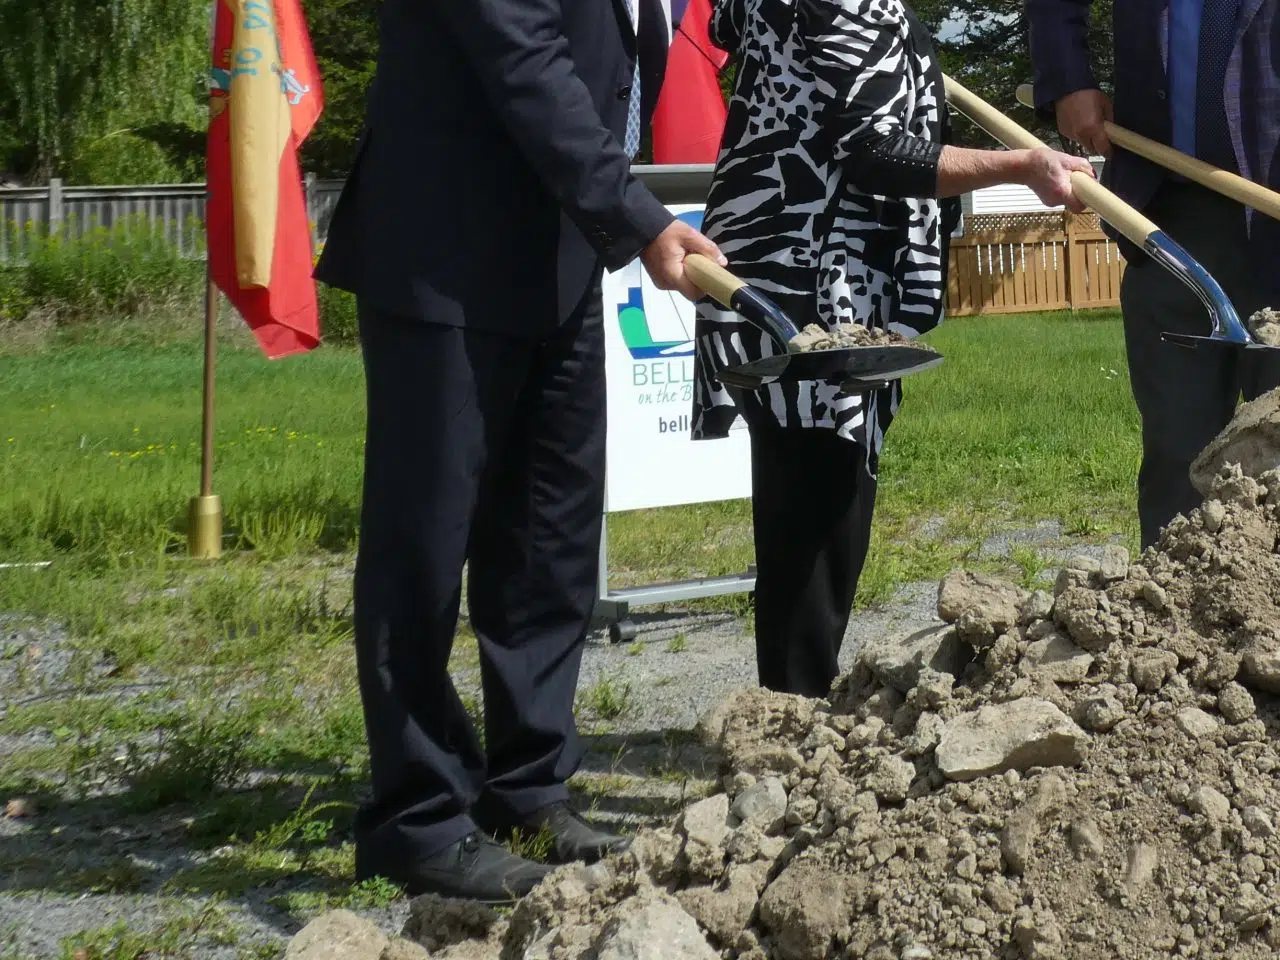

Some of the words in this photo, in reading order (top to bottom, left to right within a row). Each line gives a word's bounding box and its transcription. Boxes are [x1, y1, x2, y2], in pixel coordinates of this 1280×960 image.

[638, 393, 653, 405] on
[656, 382, 678, 404] the
[659, 415, 693, 433] bell
